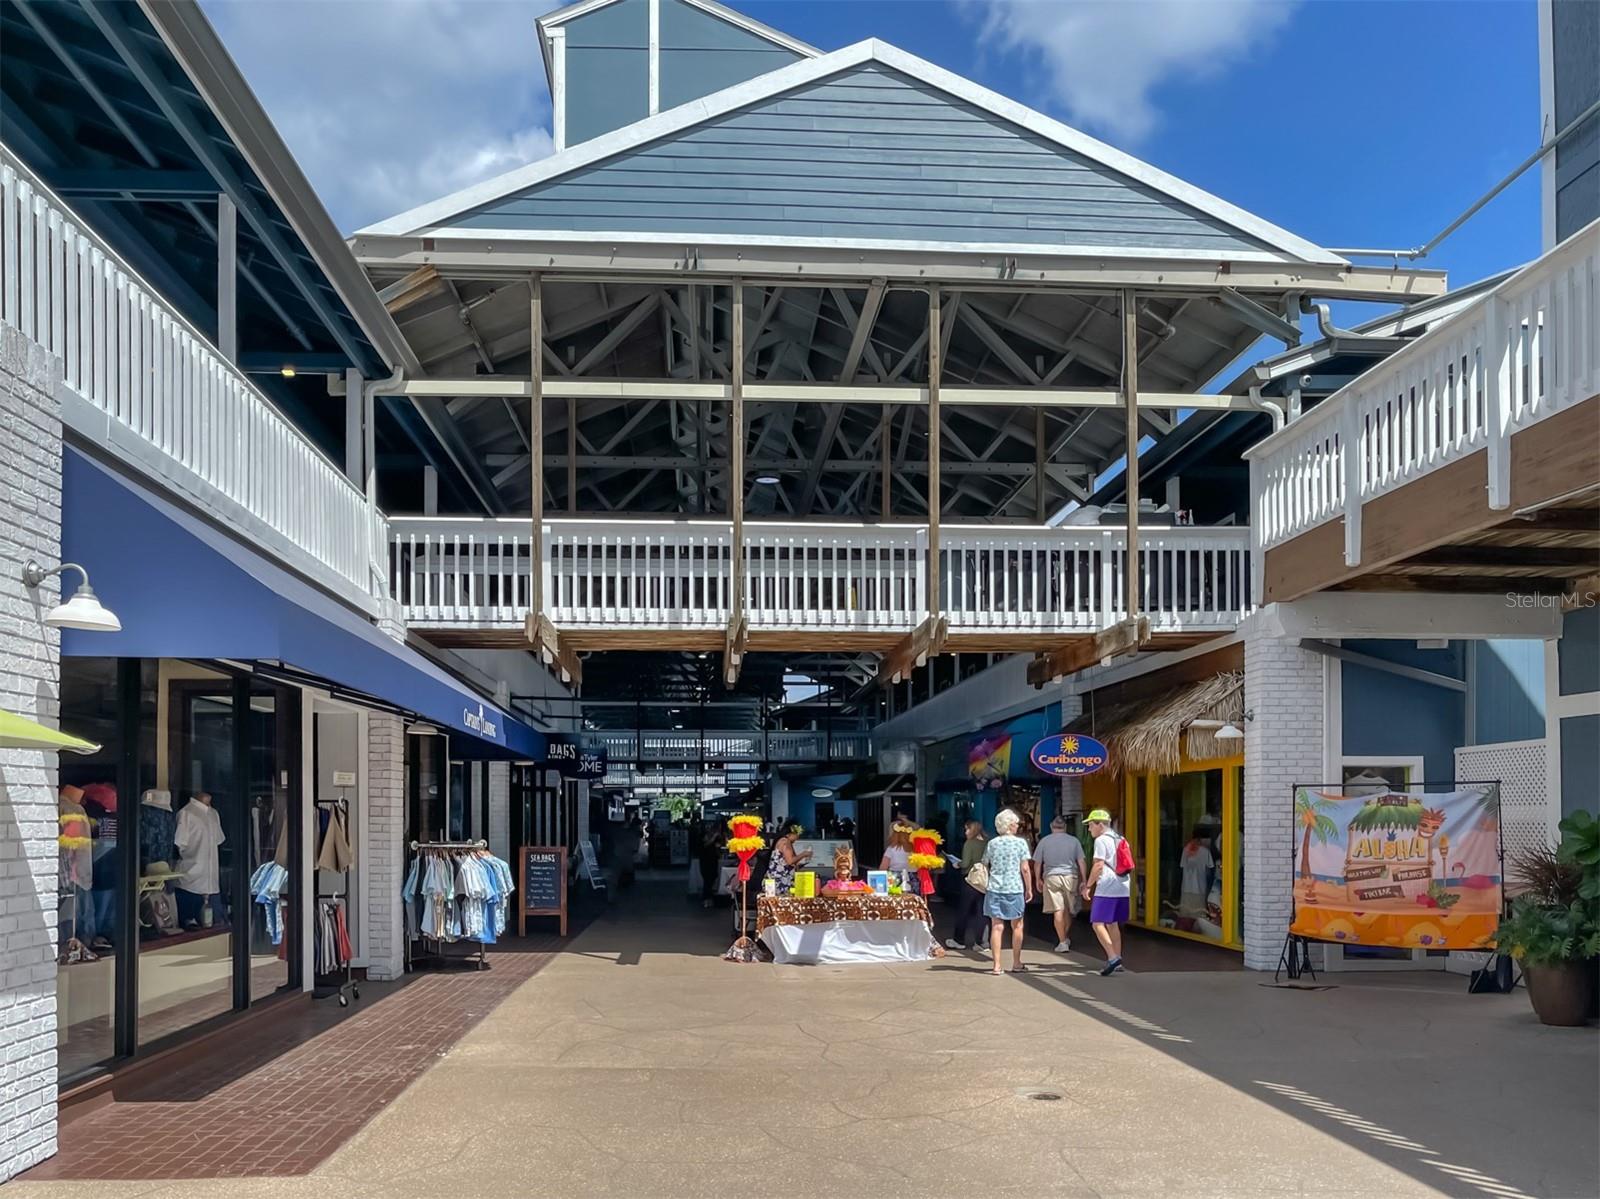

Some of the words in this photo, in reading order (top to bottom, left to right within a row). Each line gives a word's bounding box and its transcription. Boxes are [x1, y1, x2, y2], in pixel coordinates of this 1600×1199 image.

[1038, 755, 1102, 767] Caribongo
[1353, 837, 1425, 861] ALOHA
[530, 854, 540, 863] SEA
